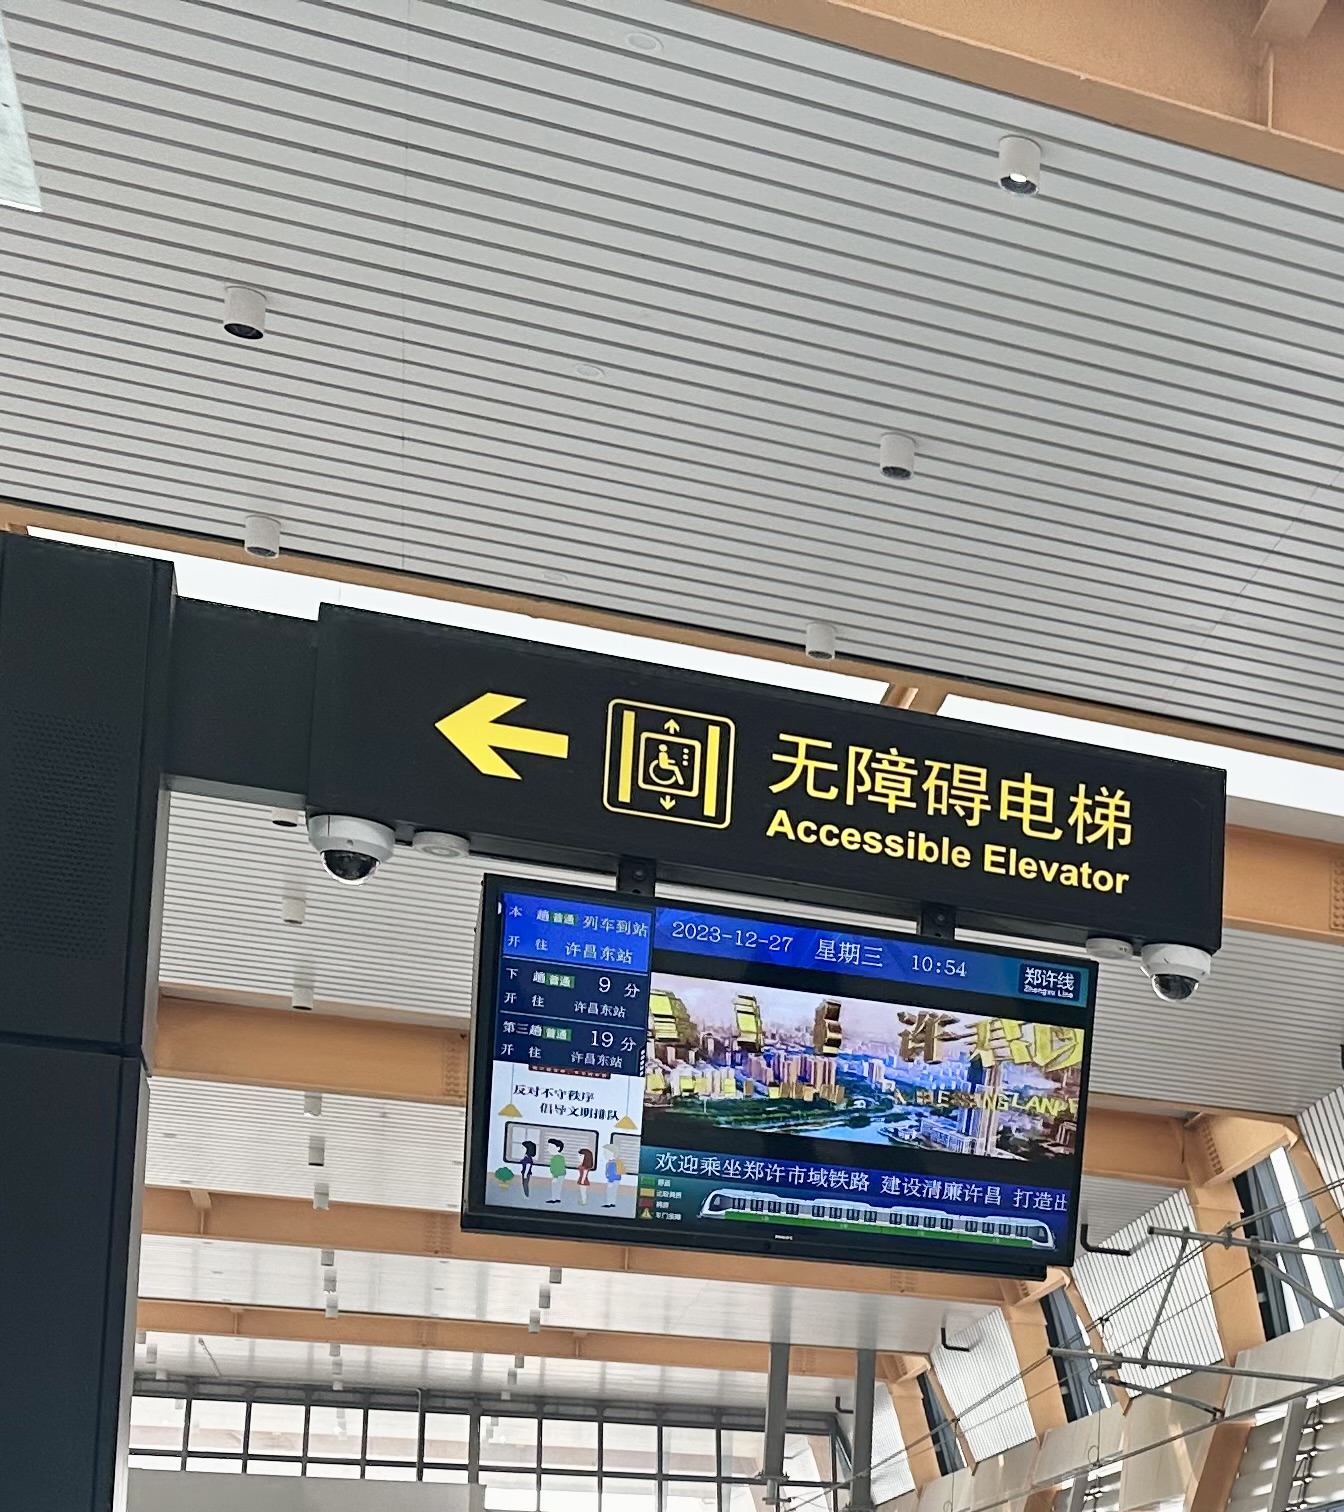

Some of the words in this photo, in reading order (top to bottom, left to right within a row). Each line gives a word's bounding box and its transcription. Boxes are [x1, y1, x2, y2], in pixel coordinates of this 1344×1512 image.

[768, 733, 1132, 850] 无障碍电梯
[766, 809, 971, 868] Accessible
[984, 843, 1130, 894] Elevator
[583, 915, 649, 937] 列车到站
[565, 942, 632, 965] 许昌东站
[672, 921, 794, 953] 2023-12-27
[814, 939, 883, 968] 星期三
[911, 954, 967, 978] 10:54
[599, 977, 611, 993] 9
[624, 983, 641, 998] 分
[1024, 967, 1074, 990] 郑许线
[574, 1001, 626, 1018] 许昌东站
[503, 1020, 542, 1037] 第三趟
[591, 1030, 613, 1047] 19
[621, 1037, 637, 1051] 分
[571, 1051, 623, 1068] 许昌东站
[513, 1084, 594, 1103] 反对不守秩序
[540, 1102, 620, 1121] 倡导文明排队
[655, 1152, 870, 1192] 欢迎乘坐郑许市域铁路
[880, 1175, 1001, 1206] 建设清廉许昌
